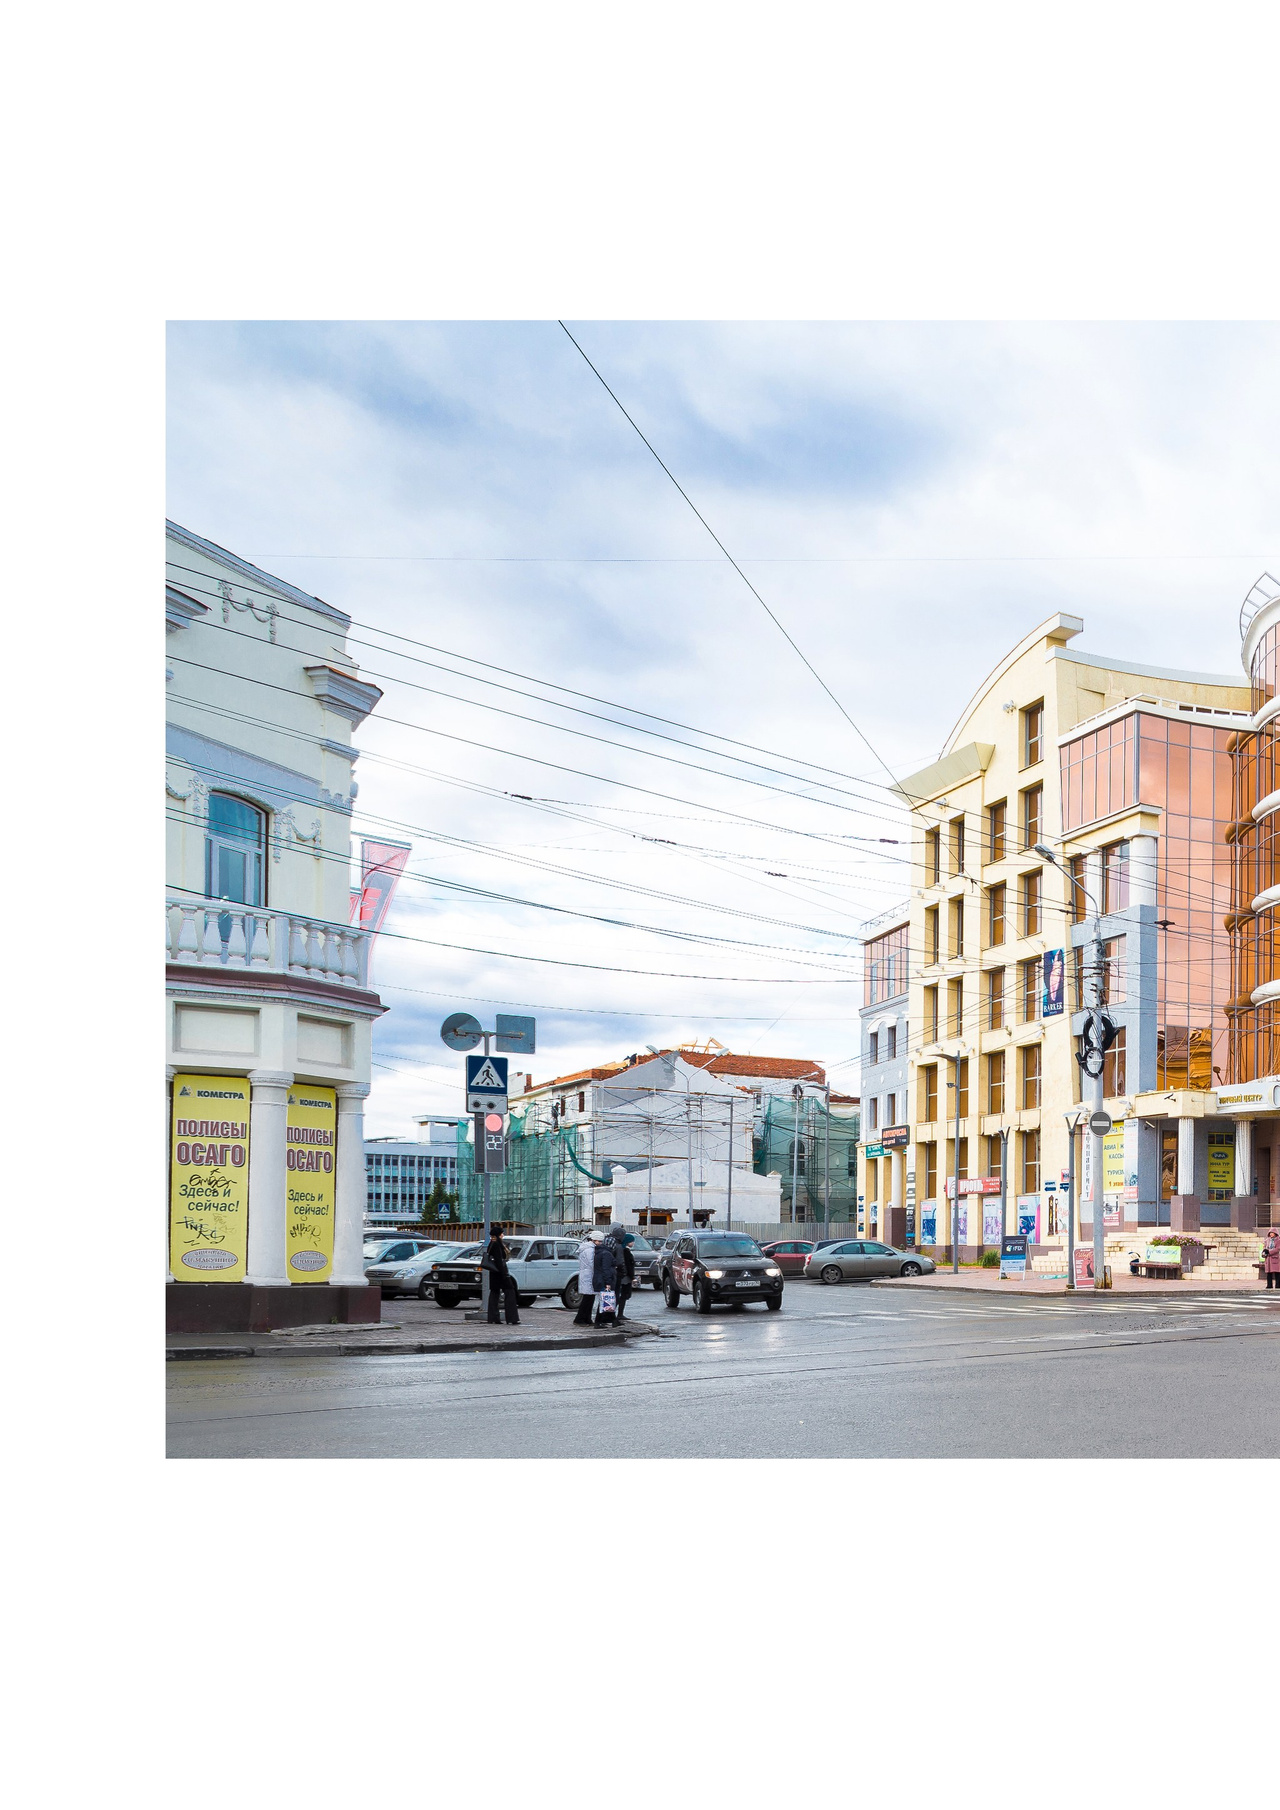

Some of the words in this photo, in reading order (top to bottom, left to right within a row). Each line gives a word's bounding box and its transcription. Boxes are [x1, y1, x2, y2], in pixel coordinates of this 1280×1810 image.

[197, 1090, 244, 1099] КОМЕСТРА
[299, 1099, 332, 1109] КОМЕСТРА
[177, 1119, 246, 1138] ПОЛИСЫ
[287, 1126, 333, 1146] ПОЛИСЫ
[176, 1142, 246, 1167] ОСАГО
[287, 1148, 332, 1173] ОСАГО
[179, 1184, 219, 1198] Здесь
[222, 1188, 231, 1197] и
[288, 1189, 315, 1202] Здесь
[317, 1193, 323, 1201] и
[188, 1200, 240, 1212] сейчас!
[294, 1204, 329, 1215] сейчас!
